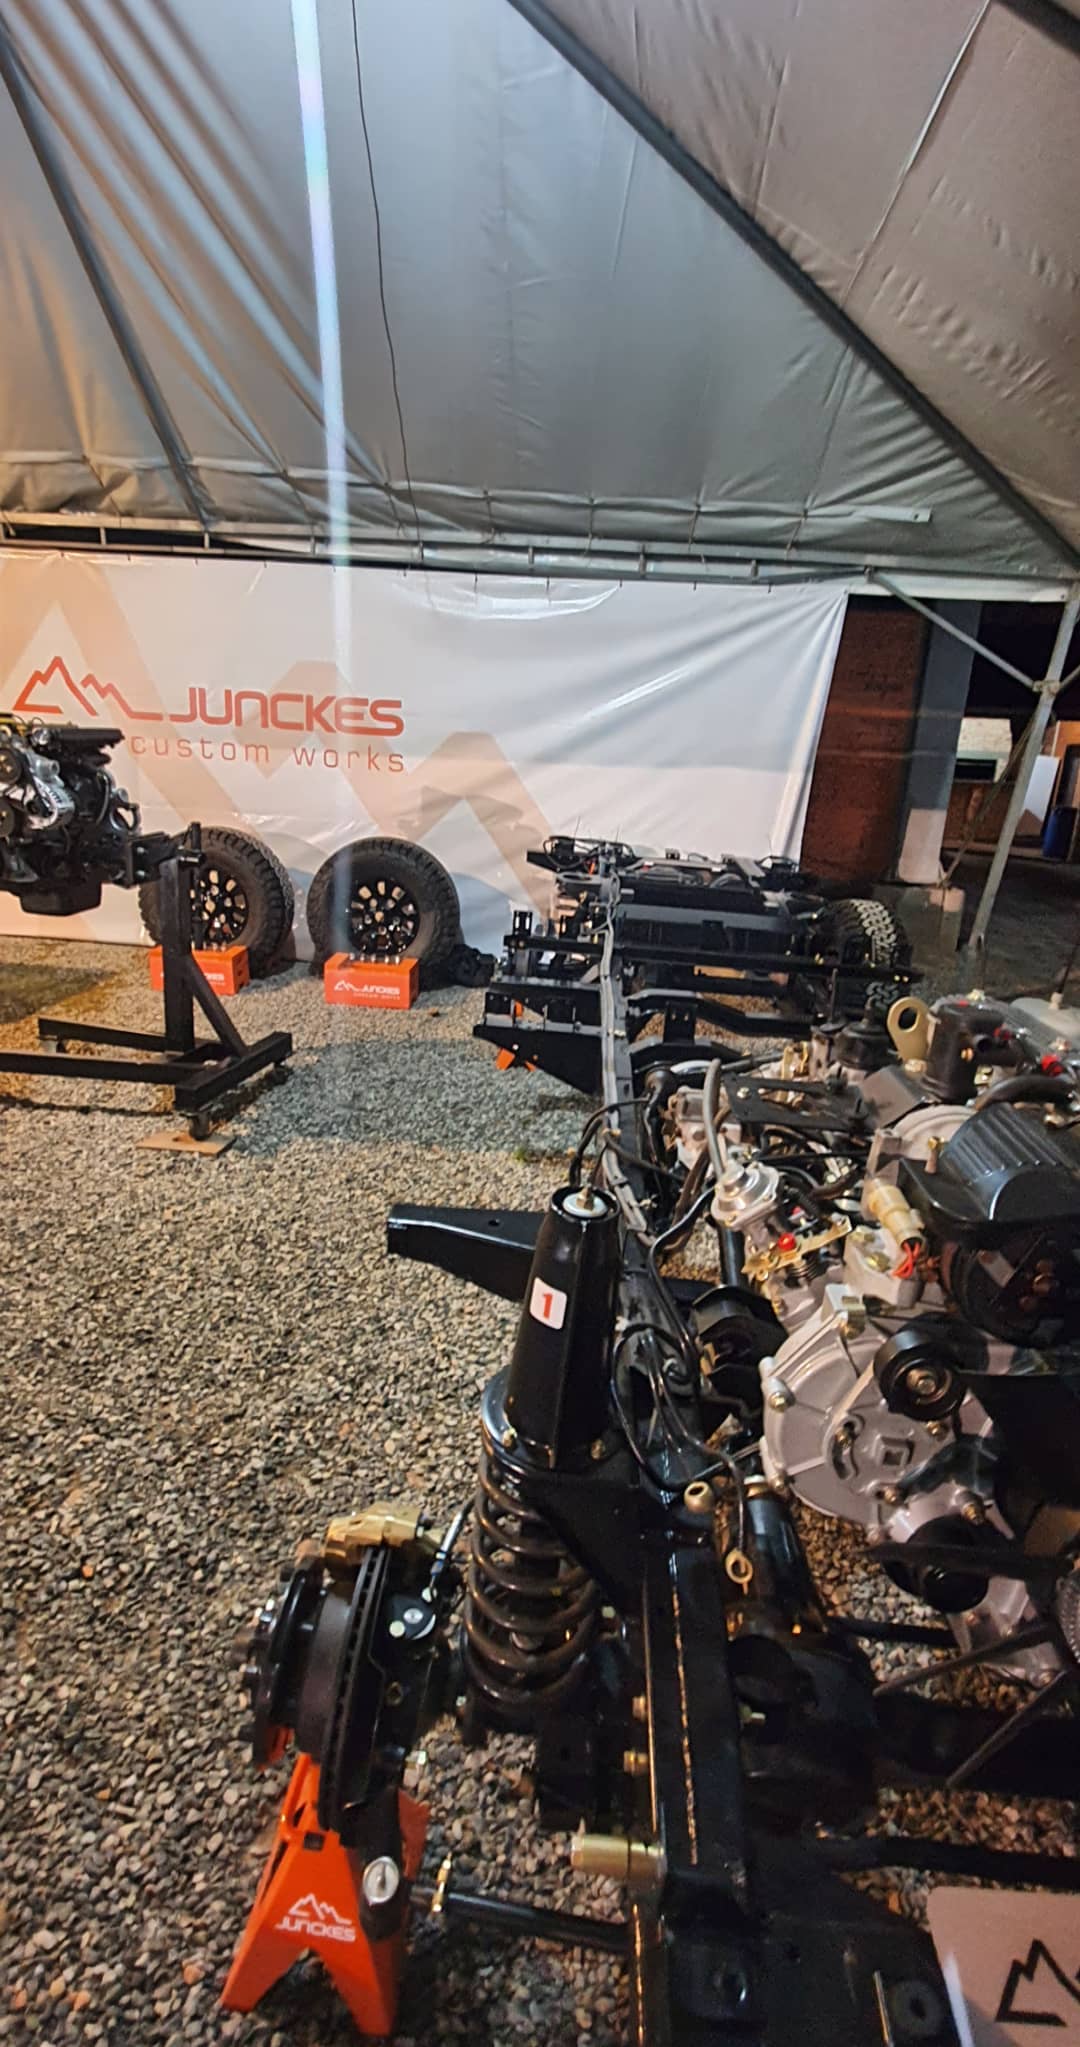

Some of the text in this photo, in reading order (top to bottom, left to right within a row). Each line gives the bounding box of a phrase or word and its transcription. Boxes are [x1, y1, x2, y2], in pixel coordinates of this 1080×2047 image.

[169, 687, 404, 736] JUNCKES
[130, 735, 405, 773] custom works
[542, 1292, 554, 1320] 1
